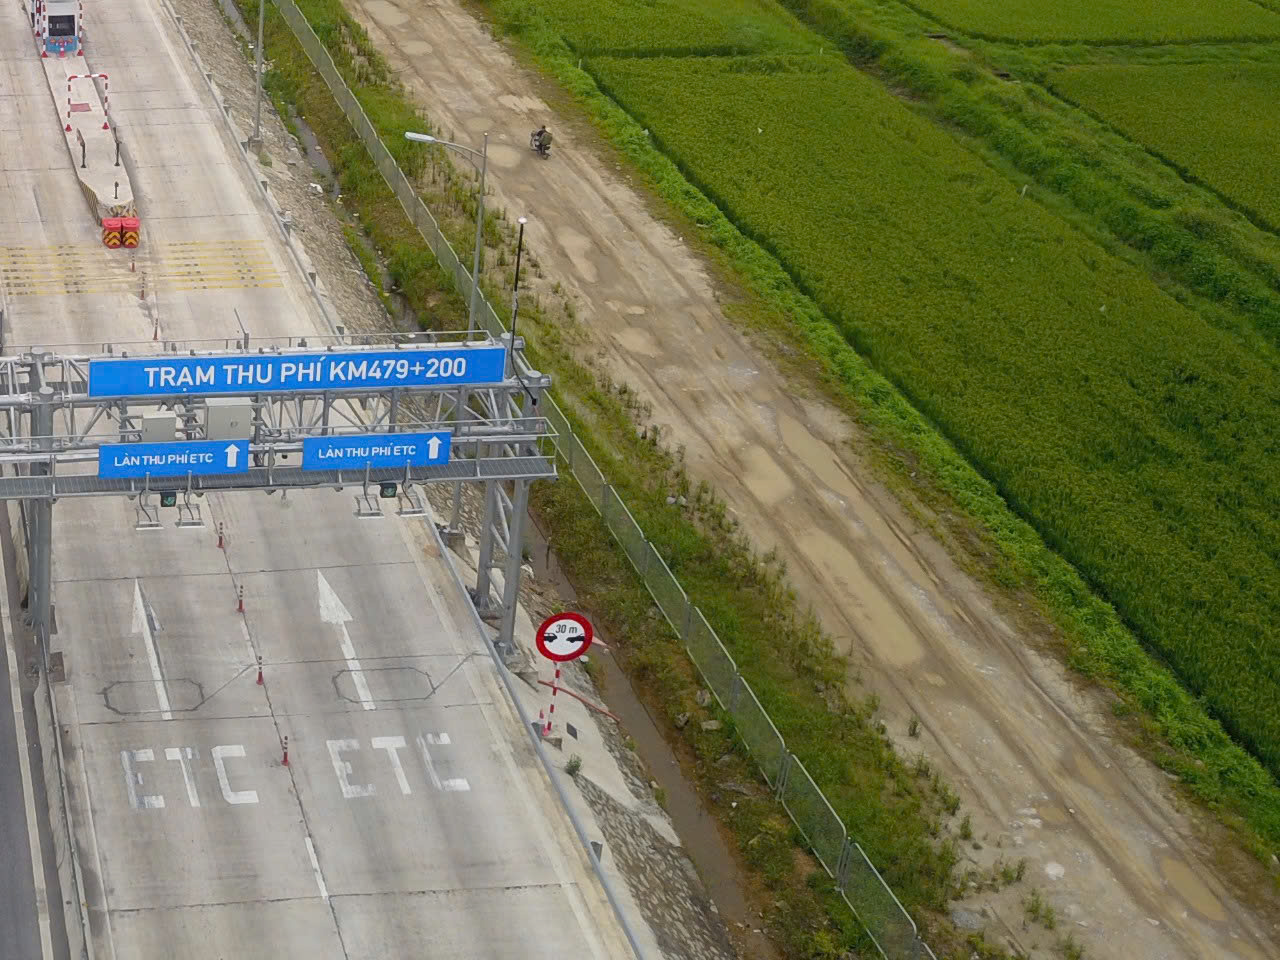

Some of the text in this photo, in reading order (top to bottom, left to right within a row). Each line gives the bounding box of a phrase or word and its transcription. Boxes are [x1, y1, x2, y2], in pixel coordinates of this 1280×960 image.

[143, 355, 467, 392] TRẠM THU PHÍ KM479+200
[114, 450, 214, 467] LÀN THU PHÍ ETC
[319, 442, 417, 459] LÀN THU PHÍ ETC
[555, 624, 578, 634] 30 m
[120, 744, 260, 809] ETC
[325, 731, 472, 798] ETC
